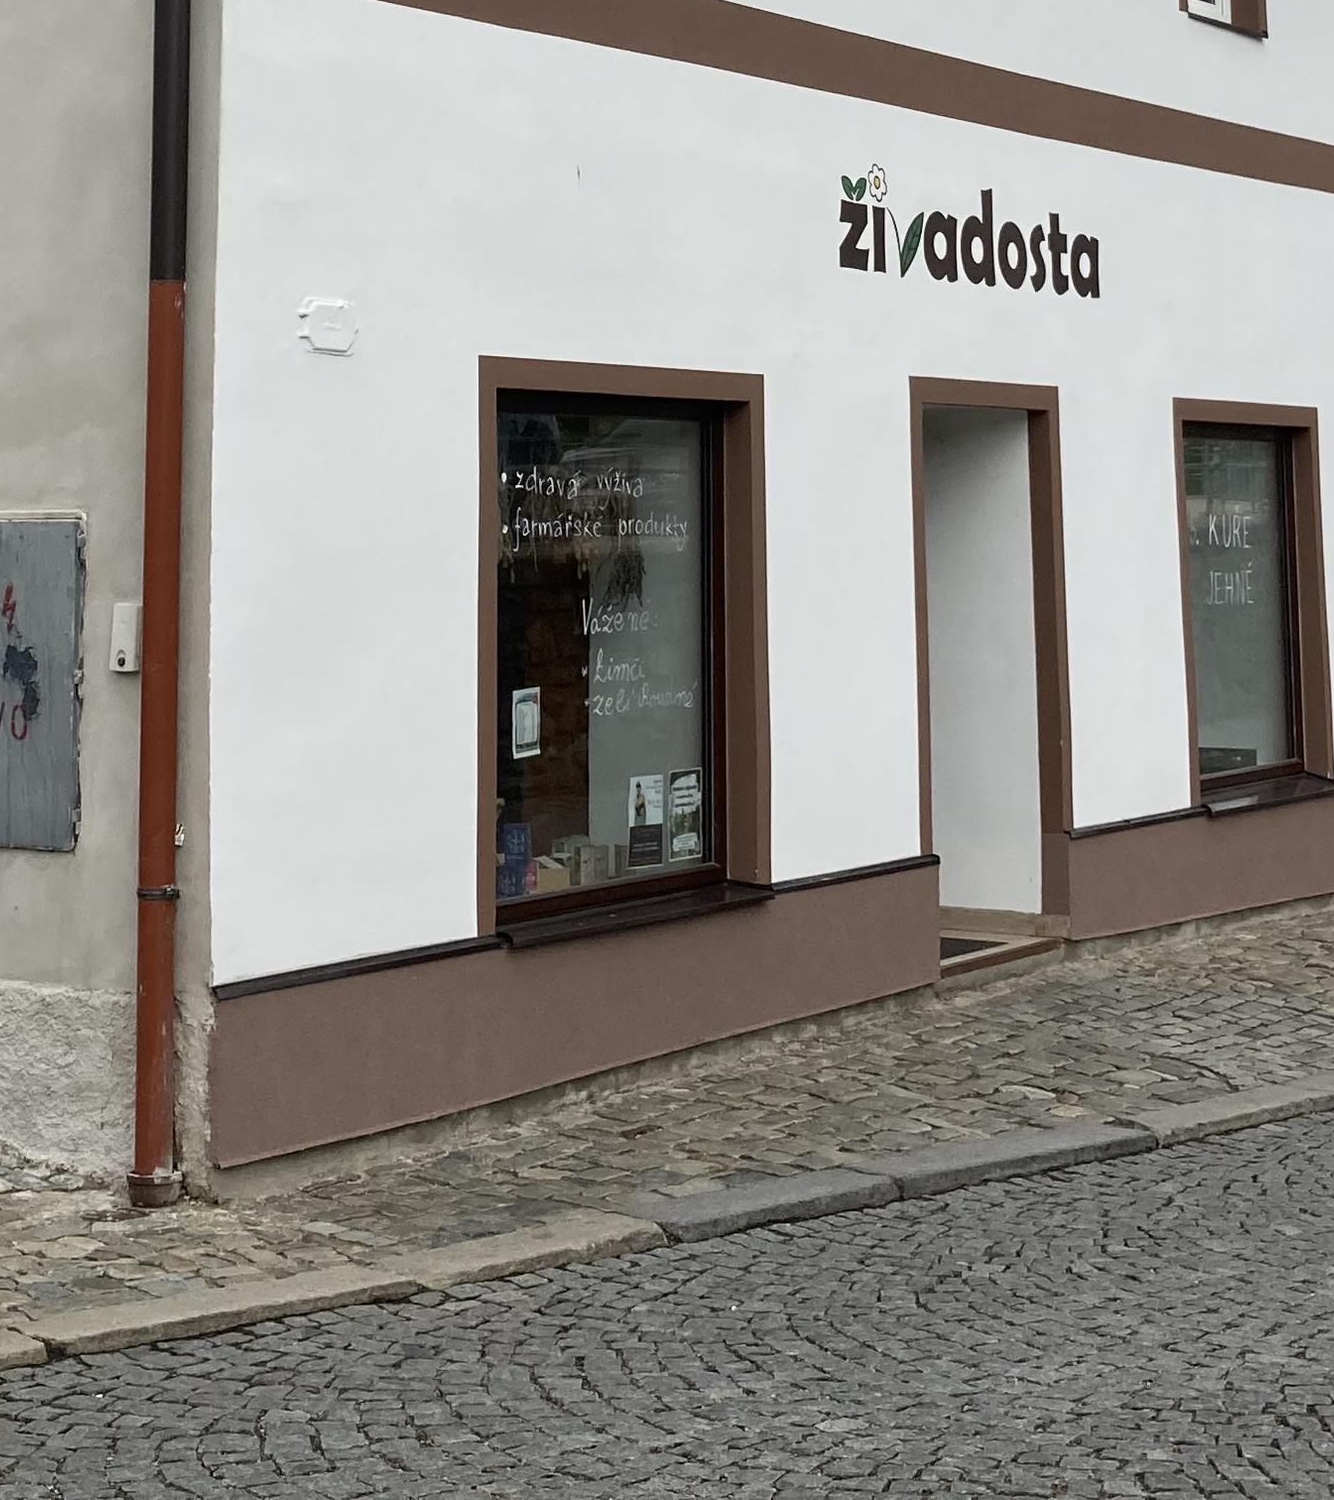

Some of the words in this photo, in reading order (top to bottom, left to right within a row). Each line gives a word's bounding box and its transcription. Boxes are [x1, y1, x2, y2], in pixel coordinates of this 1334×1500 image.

[839, 164, 1101, 299] živadosta
[515, 466, 582, 500] zdravá
[597, 467, 644, 510] výživa
[513, 507, 604, 552] farmářské
[618, 511, 689, 551] produkty
